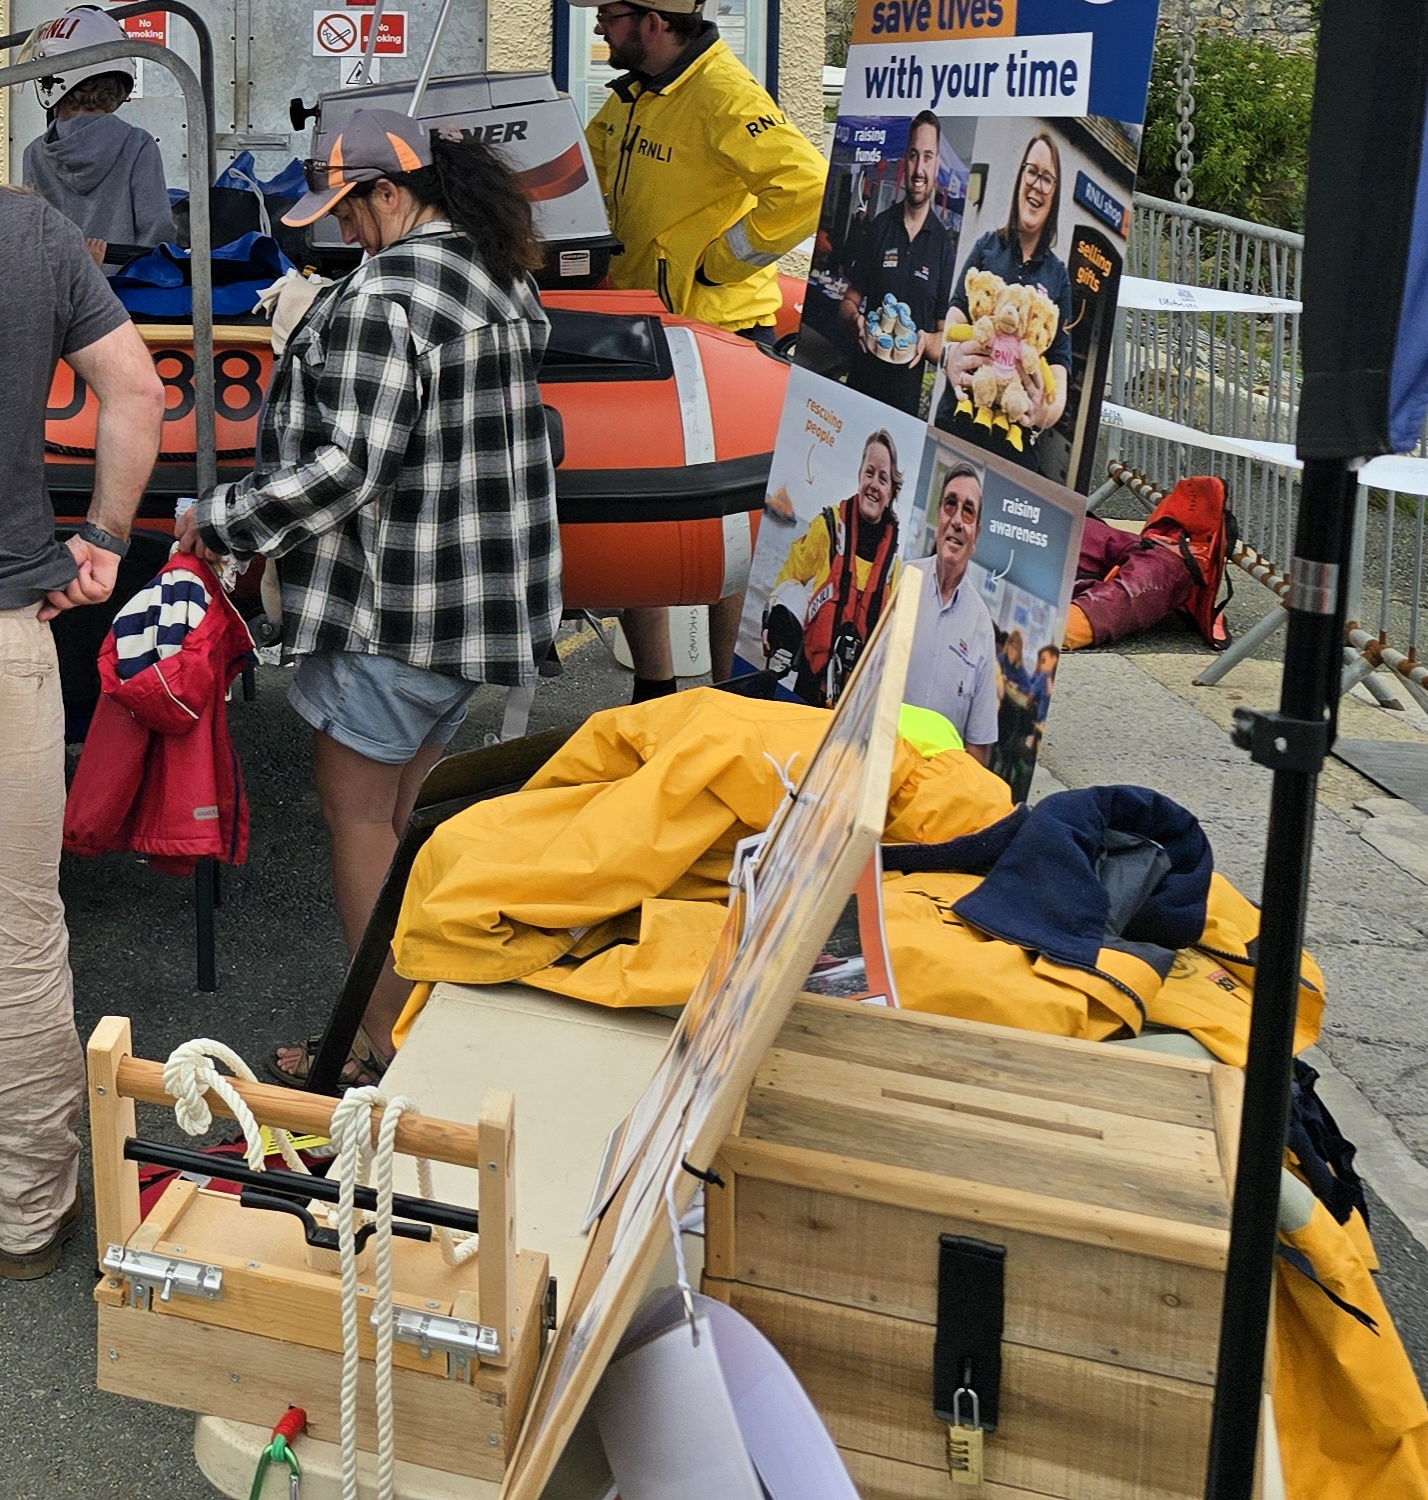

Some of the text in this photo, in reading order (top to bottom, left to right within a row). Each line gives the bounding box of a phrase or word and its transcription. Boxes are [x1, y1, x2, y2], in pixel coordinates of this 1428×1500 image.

[126, 30, 164, 40] smoking
[139, 19, 152, 28] No
[363, 34, 402, 45] soking
[865, 50, 1078, 110] with your time
[854, 127, 887, 145] raising
[637, 138, 673, 163] RNLI
[855, 147, 882, 162] funds
[1102, 200, 1123, 228] shop
[1078, 238, 1113, 277] selling
[1076, 266, 1101, 293] gifts
[806, 397, 844, 434] rescuing
[805, 417, 836, 449] people
[1002, 496, 1041, 524] raising
[989, 518, 1049, 547] awareness
